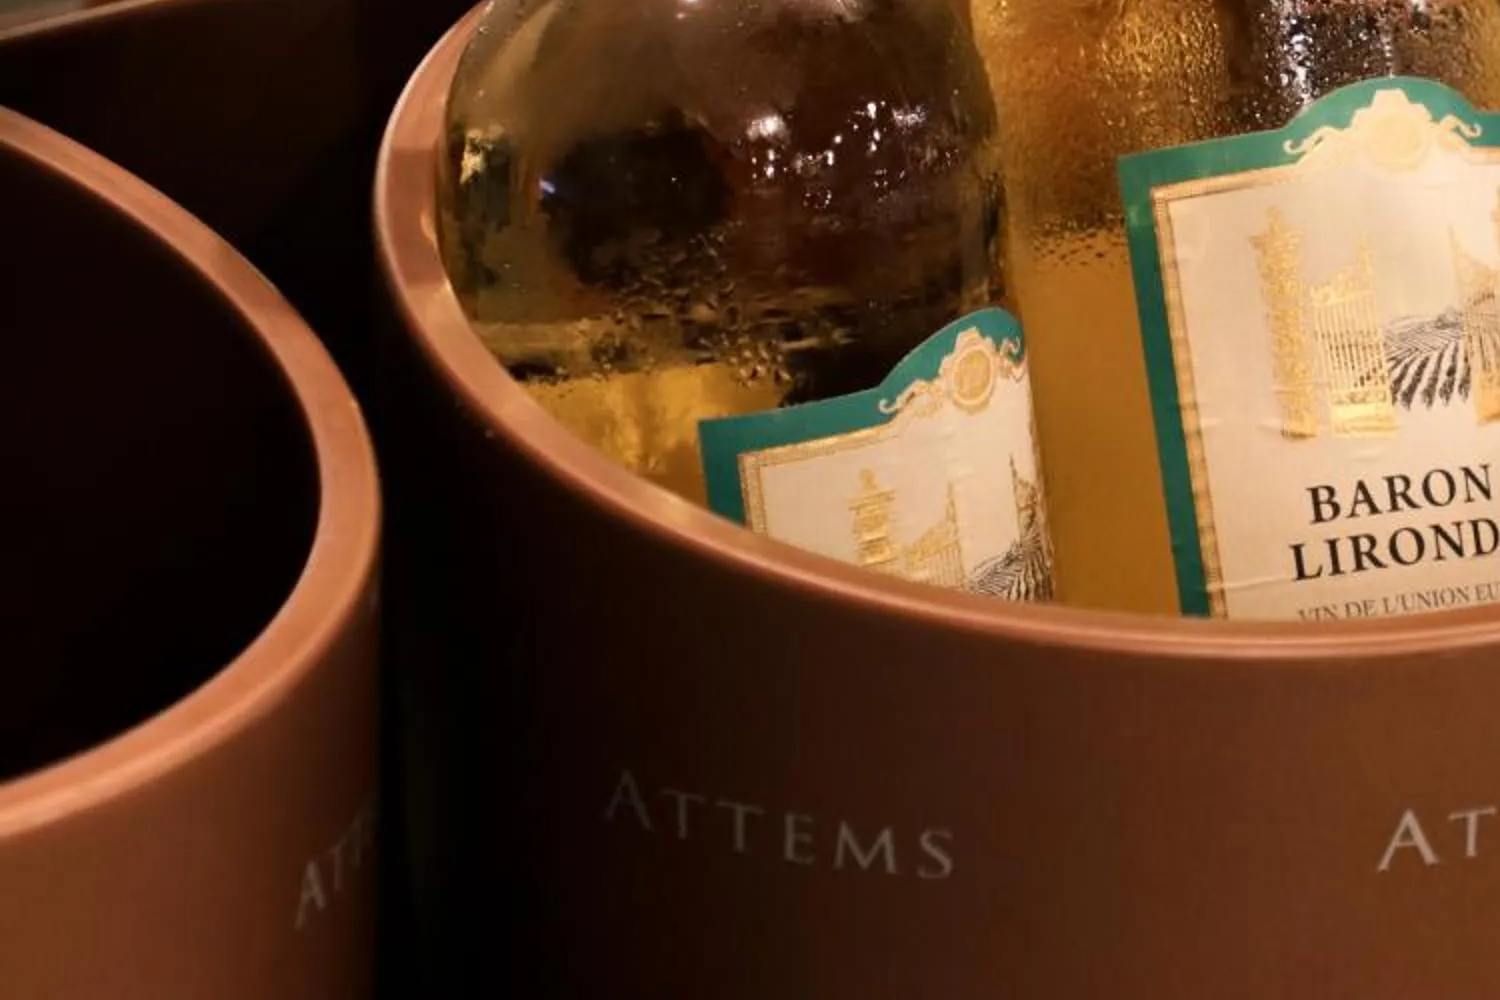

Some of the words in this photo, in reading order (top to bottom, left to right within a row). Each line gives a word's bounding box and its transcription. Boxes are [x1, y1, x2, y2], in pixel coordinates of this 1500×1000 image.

[1305, 463, 1493, 525] BARON
[1344, 600, 1376, 618] DE
[605, 769, 954, 879] ATTEMS
